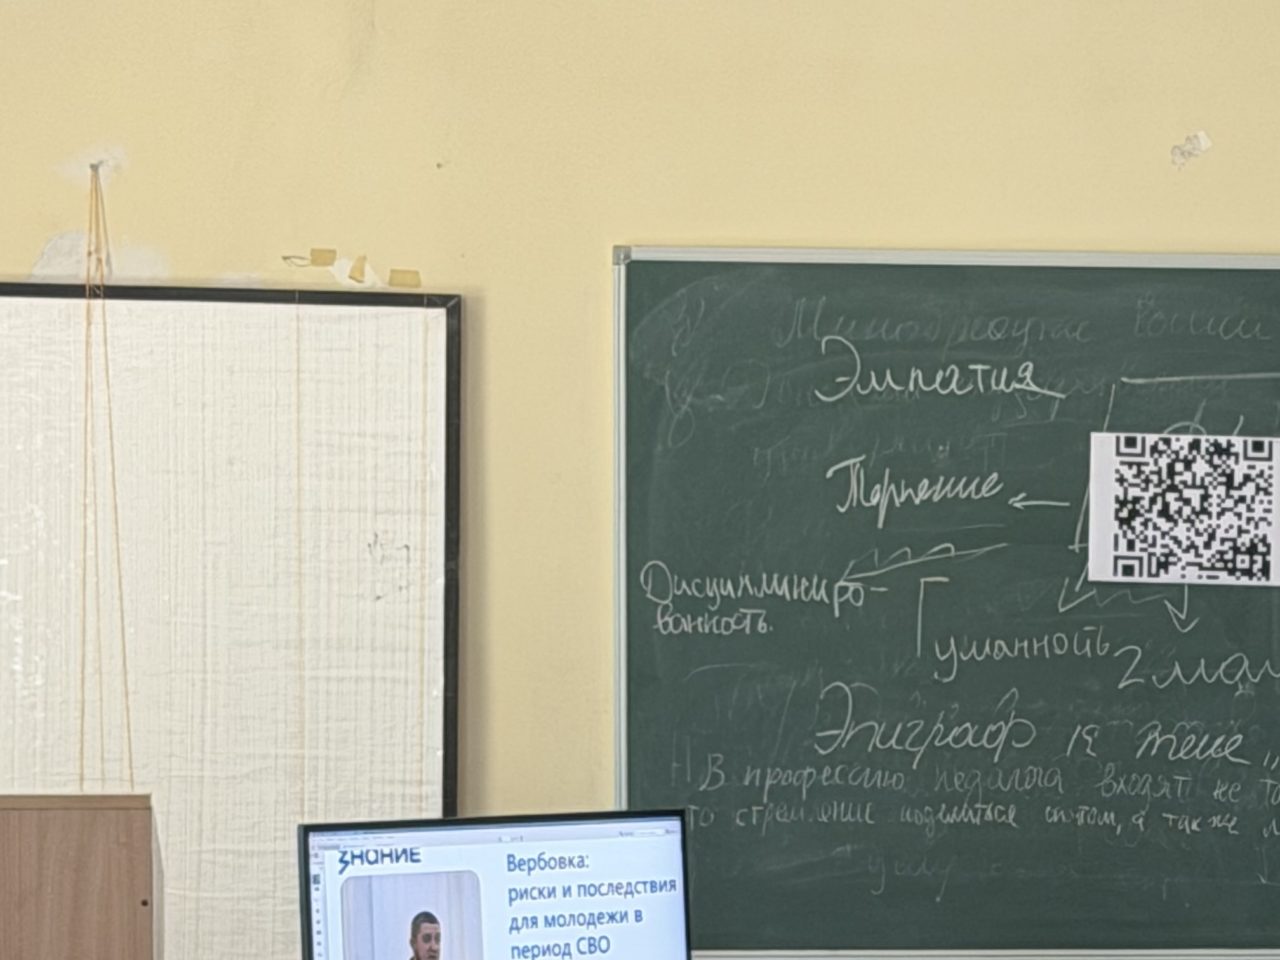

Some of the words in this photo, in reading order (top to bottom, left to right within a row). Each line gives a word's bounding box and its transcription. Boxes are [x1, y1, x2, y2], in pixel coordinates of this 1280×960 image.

[814, 334, 1067, 402] Эмпатия
[813, 681, 1037, 770] Эпиграф
[506, 851, 590, 876] Вербовка:
[507, 884, 557, 907] риски
[561, 884, 573, 899] и
[577, 878, 677, 899] последствия
[508, 915, 539, 935] для
[544, 909, 629, 931] молодежи
[633, 909, 644, 923] в
[576, 935, 611, 956] СВО
